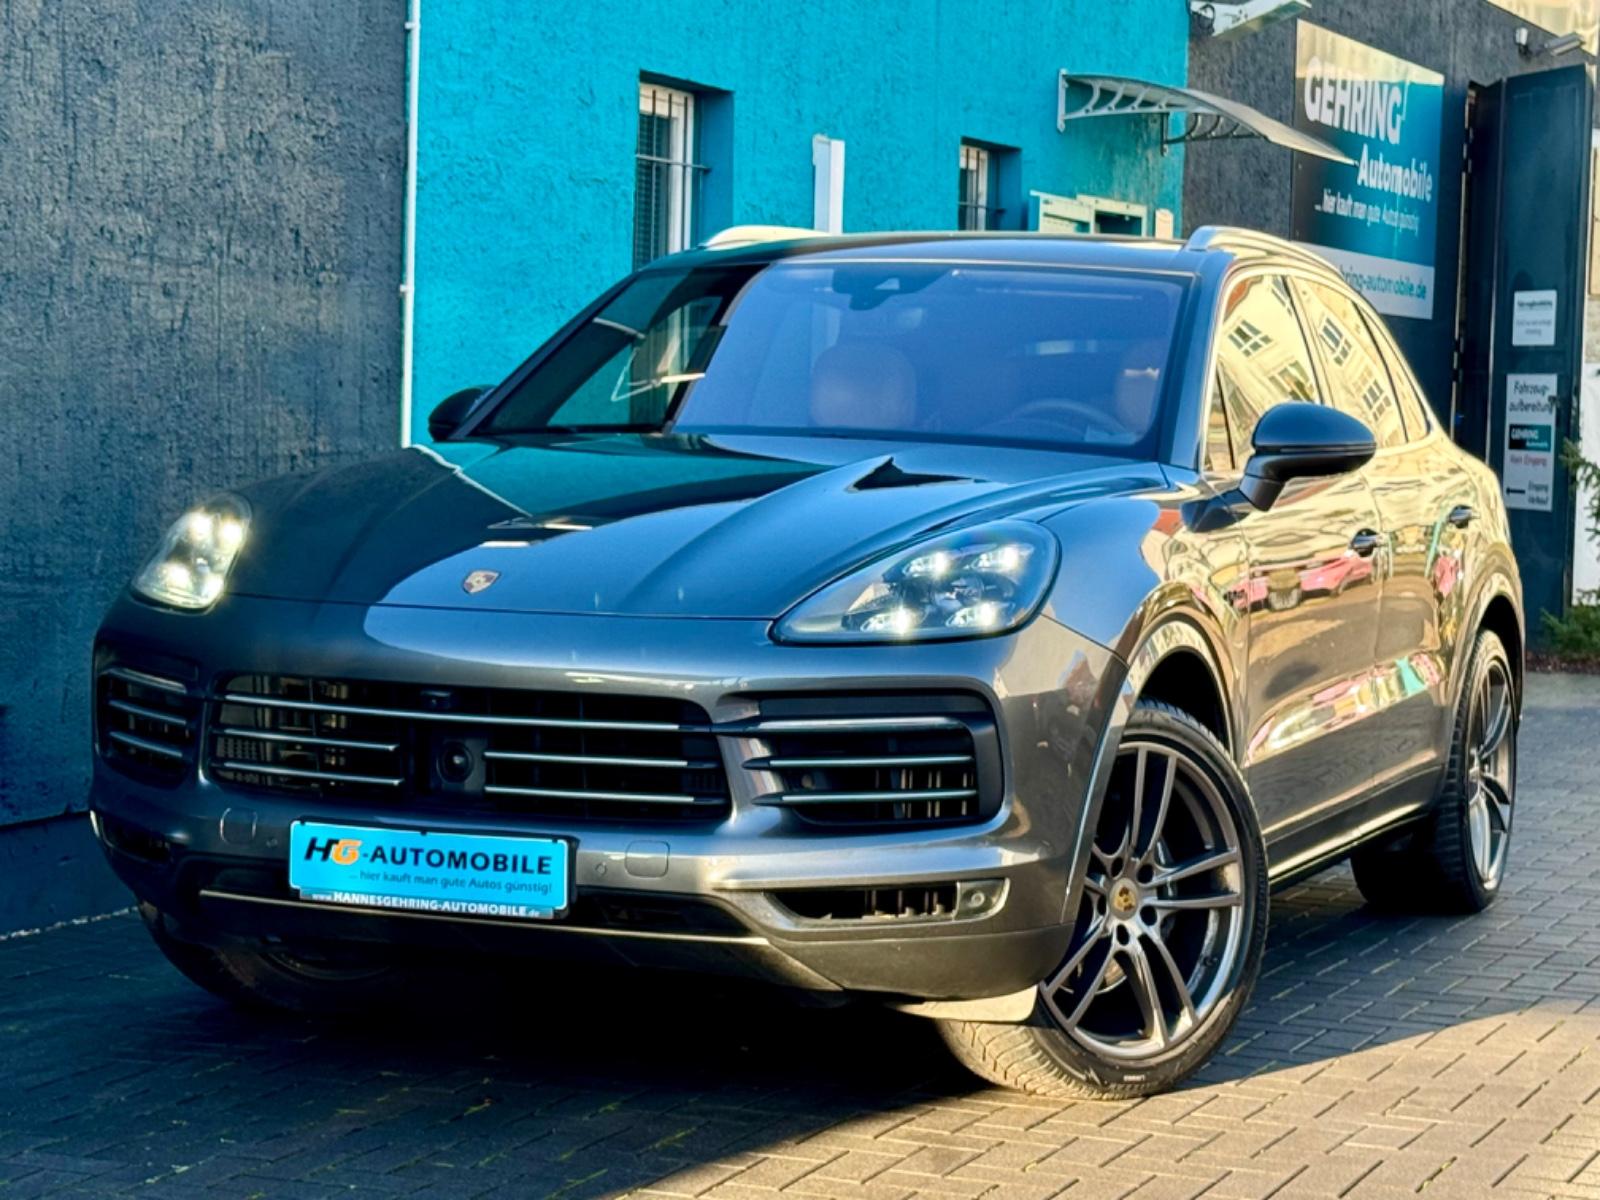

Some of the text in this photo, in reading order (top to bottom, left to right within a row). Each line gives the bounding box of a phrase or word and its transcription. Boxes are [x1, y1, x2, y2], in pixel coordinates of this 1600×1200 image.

[1304, 56, 1402, 145] GEHRING
[1357, 143, 1433, 202] Automobile
[383, 872, 411, 884] kauft
[414, 875, 438, 885] man
[440, 878, 466, 889] gute
[469, 878, 502, 890] Autos
[505, 881, 552, 896] günstig!
